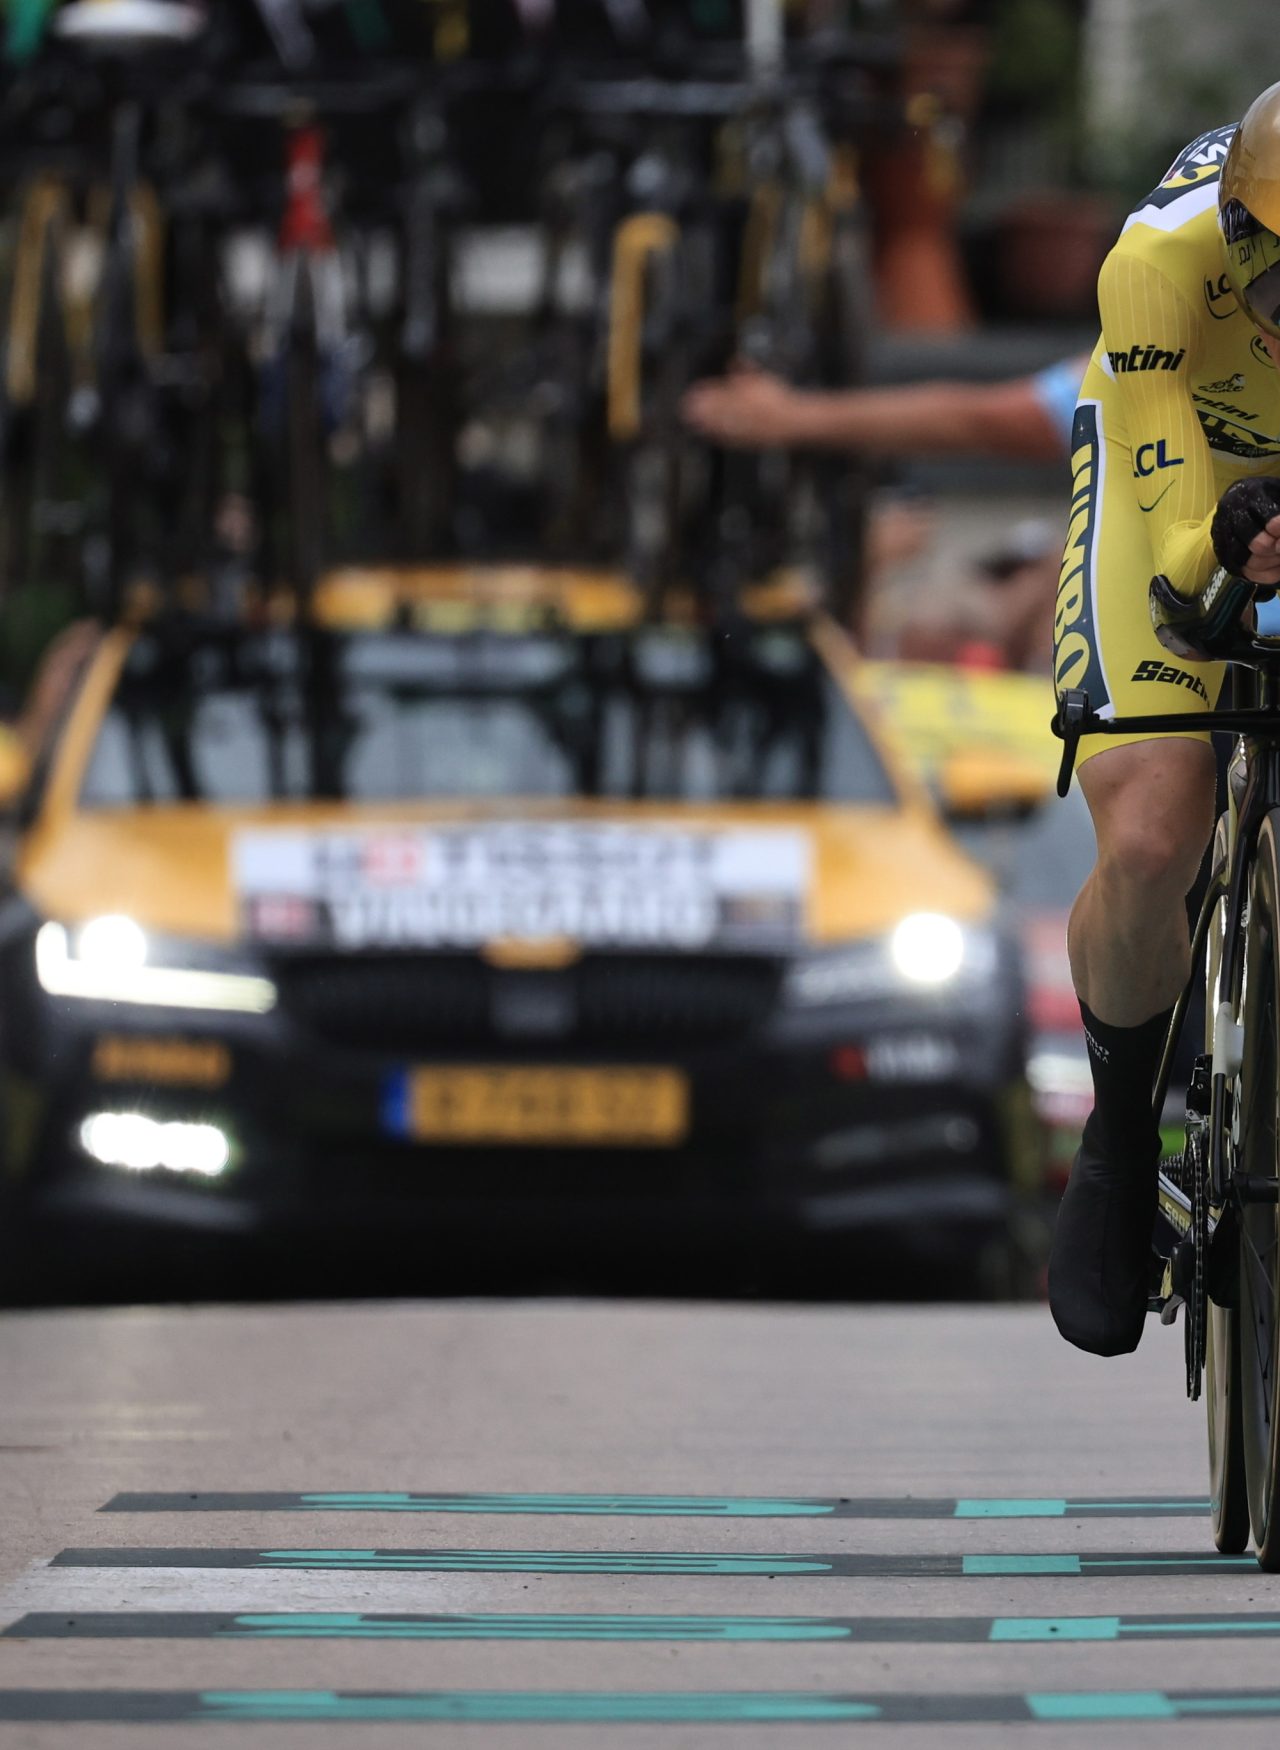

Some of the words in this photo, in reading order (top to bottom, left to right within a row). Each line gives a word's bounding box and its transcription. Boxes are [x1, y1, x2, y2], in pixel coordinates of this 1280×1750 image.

[1206, 273, 1233, 302] LC
[1107, 344, 1187, 373] antini
[1133, 438, 1185, 478] CL
